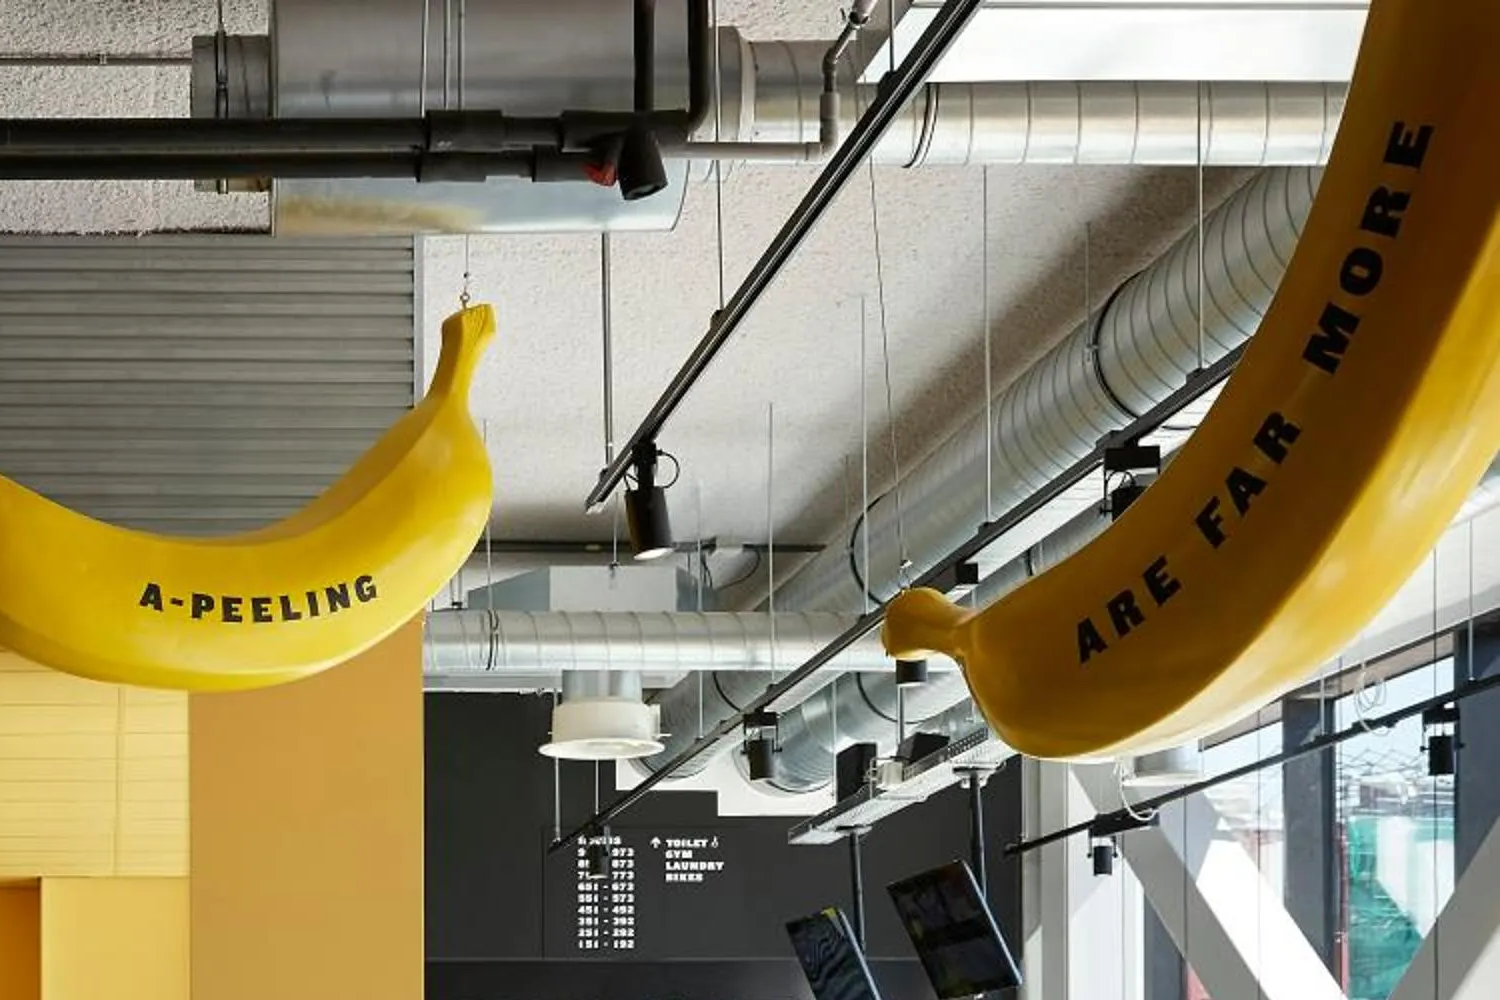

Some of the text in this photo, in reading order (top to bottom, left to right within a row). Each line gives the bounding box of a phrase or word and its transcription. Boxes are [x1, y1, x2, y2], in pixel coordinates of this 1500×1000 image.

[1076, 121, 1435, 664] ARE FAR MORE
[139, 575, 378, 623] A-PEELING
[665, 839, 708, 848] TOILET
[665, 850, 693, 859] GYM
[665, 861, 724, 871] LAUNDRY
[612, 871, 634, 880] 773
[665, 873, 703, 882] BIKES
[578, 882, 599, 891] 651
[612, 882, 634, 891] 673
[578, 905, 599, 914] 451
[612, 905, 634, 914] 492
[578, 939, 599, 948] 151
[612, 939, 634, 948] 192
